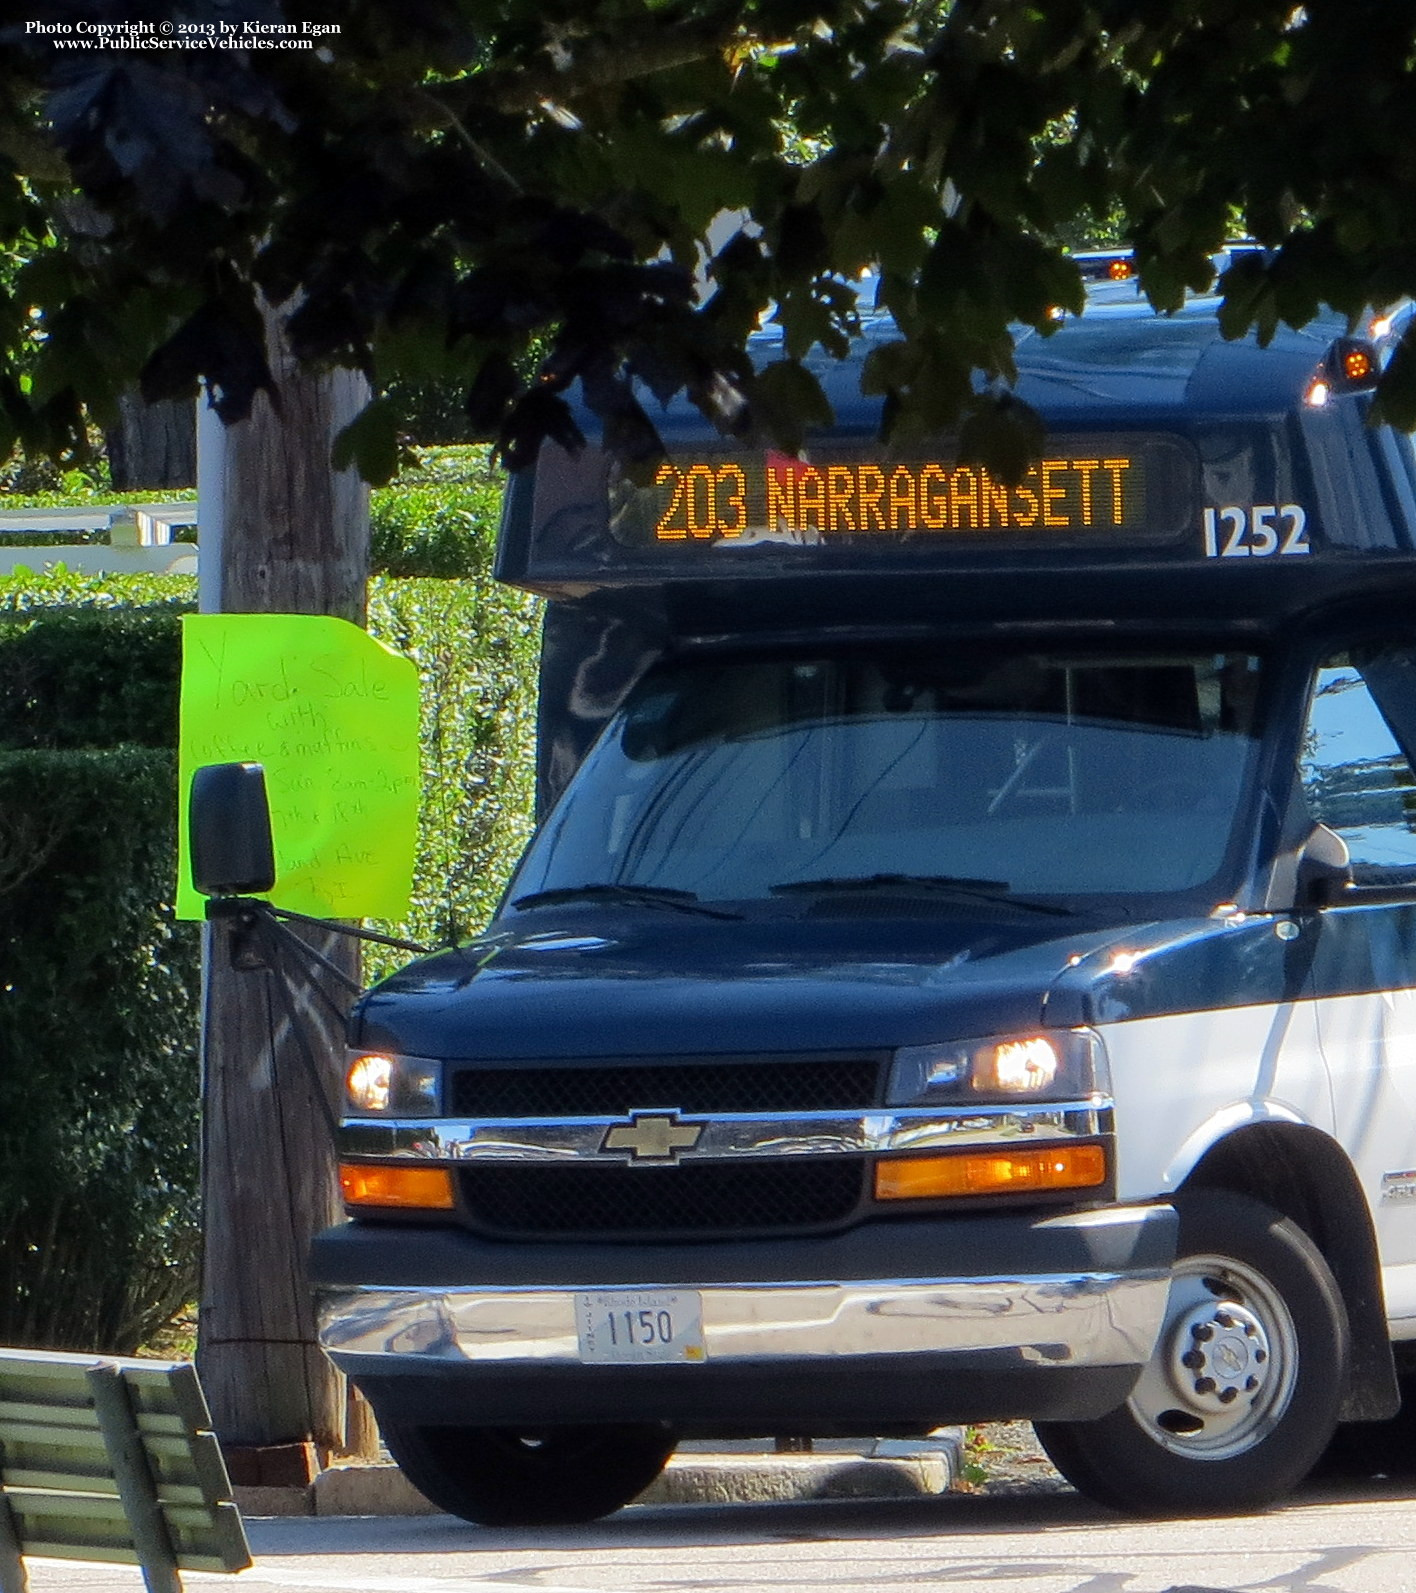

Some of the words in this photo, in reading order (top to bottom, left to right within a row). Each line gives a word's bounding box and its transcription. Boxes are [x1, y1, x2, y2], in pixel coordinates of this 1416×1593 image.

[655, 463, 747, 540] 203
[767, 459, 1130, 532] NARRAGANSETT
[1203, 505, 1310, 558] 1252
[309, 656, 390, 702] Sale
[608, 1310, 672, 1345] 1150
